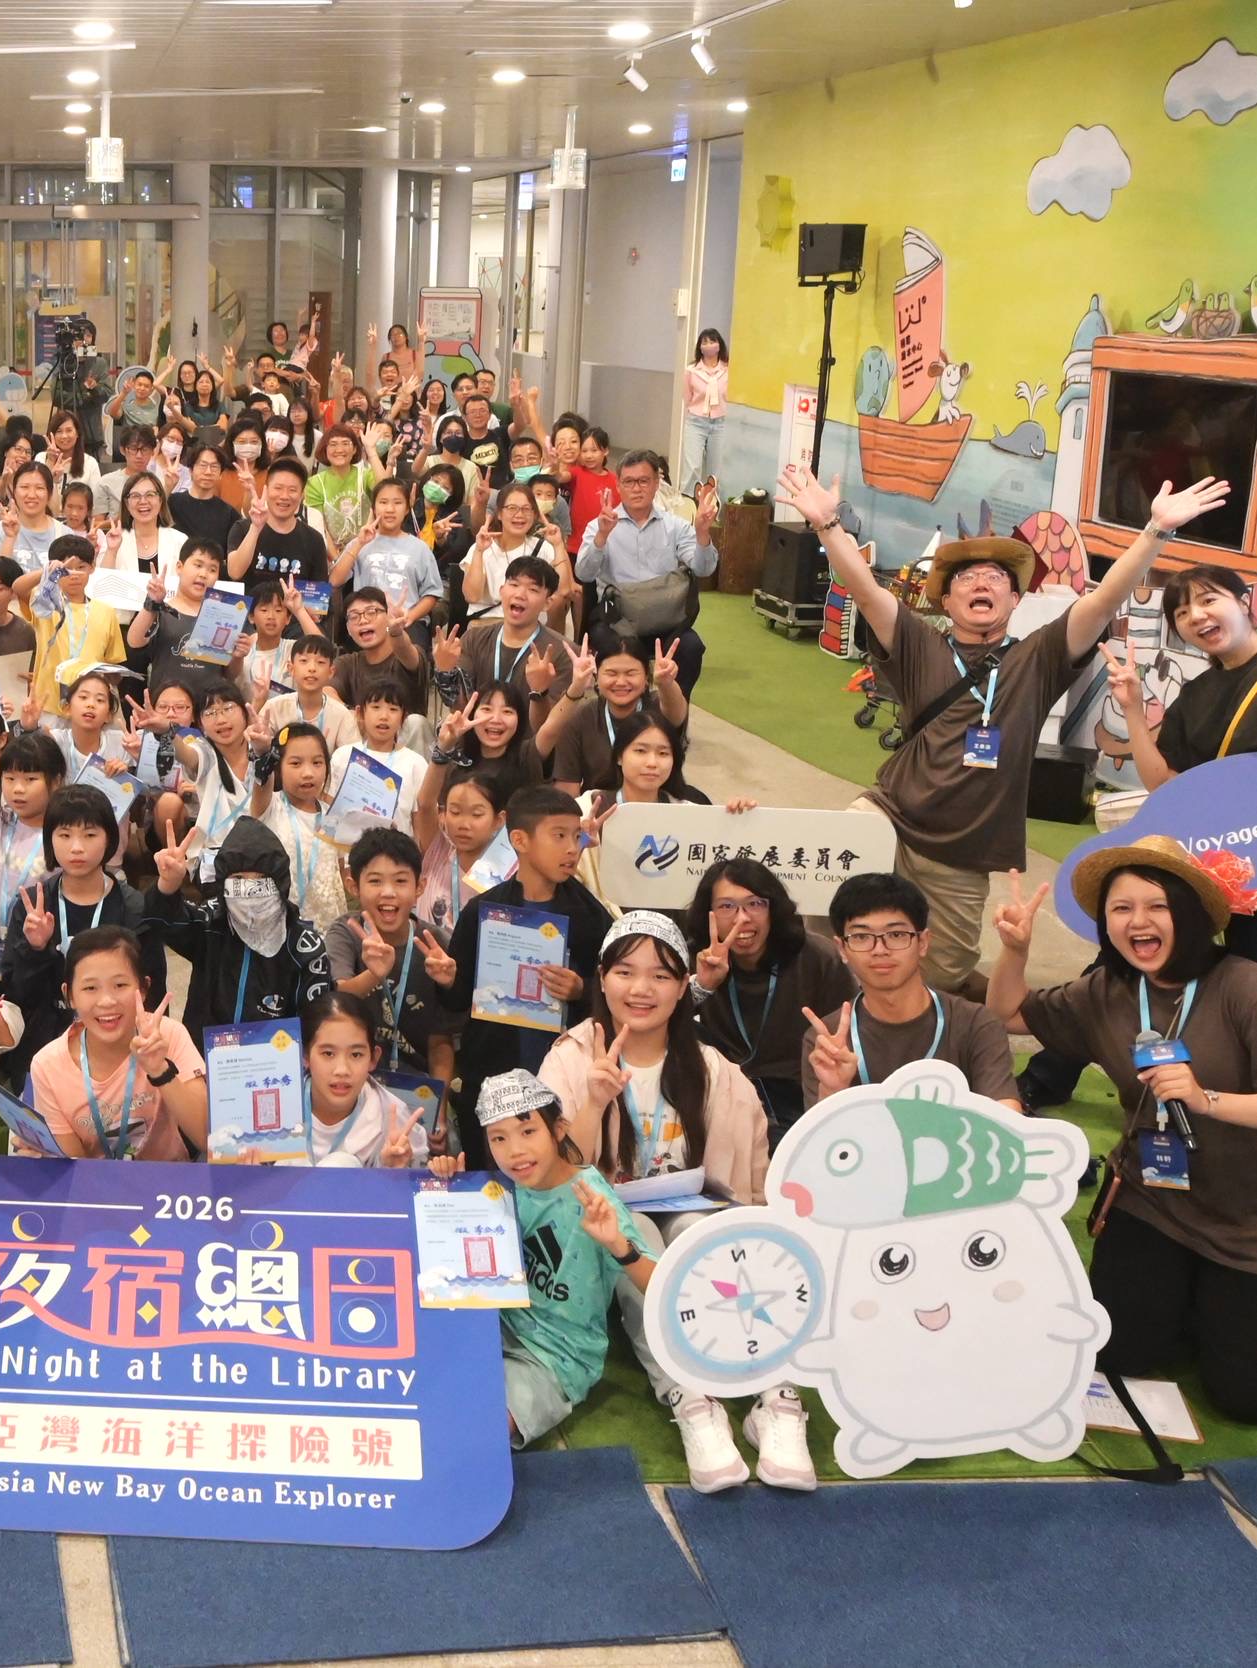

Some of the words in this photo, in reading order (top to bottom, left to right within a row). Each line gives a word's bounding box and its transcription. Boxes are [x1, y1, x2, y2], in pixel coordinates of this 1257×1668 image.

[687, 842, 861, 872] 國家發展委員會
[154, 1194, 234, 1222] 2026
[524, 1252, 570, 1302] didas
[1, 1345, 101, 1382] Night
[127, 1351, 163, 1381] at
[192, 1354, 248, 1385] the
[271, 1357, 416, 1396] Library
[47, 1471, 104, 1497] New
[116, 1474, 165, 1502] Bay
[178, 1478, 264, 1504] Ocean
[274, 1481, 397, 1510] Explorer
